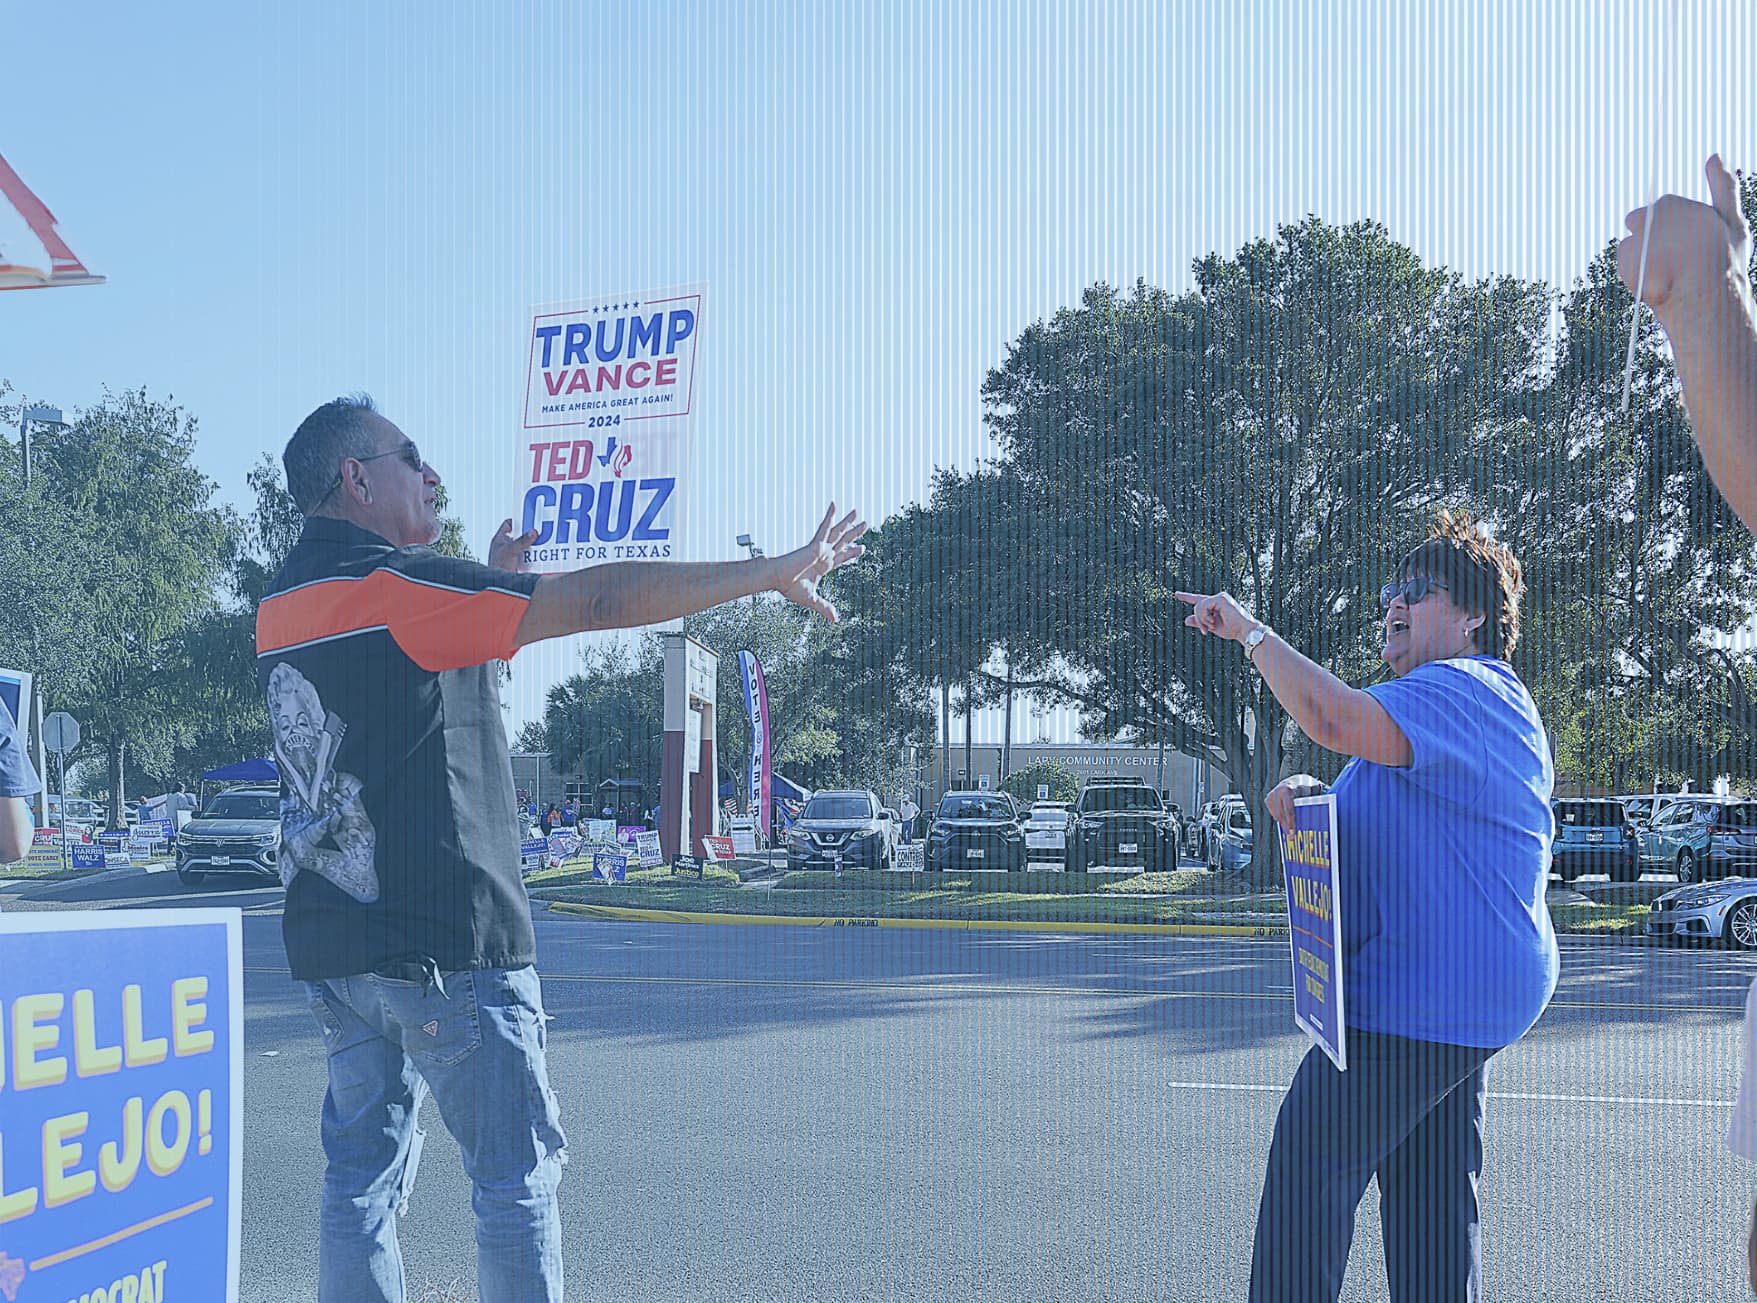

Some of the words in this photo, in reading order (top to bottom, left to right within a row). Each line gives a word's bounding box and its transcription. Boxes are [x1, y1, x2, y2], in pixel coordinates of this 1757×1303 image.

[536, 308, 694, 369] TRUMP
[543, 357, 678, 397] VANCE
[541, 403, 566, 414] MAKE
[568, 400, 607, 412] AMERICA
[610, 397, 639, 409] GREAT
[642, 393, 674, 404] AGAIN!
[588, 414, 621, 428] 2024
[529, 439, 594, 484] TED
[522, 477, 676, 547] CRUZ
[523, 547, 570, 564] RIGHT
[576, 546, 607, 560] FOR
[614, 544, 671, 559] TEXAS
[1060, 756, 1122, 765] COMMUNITY
[1124, 756, 1168, 766] CENTER
[0, 976, 214, 1091] ELLE
